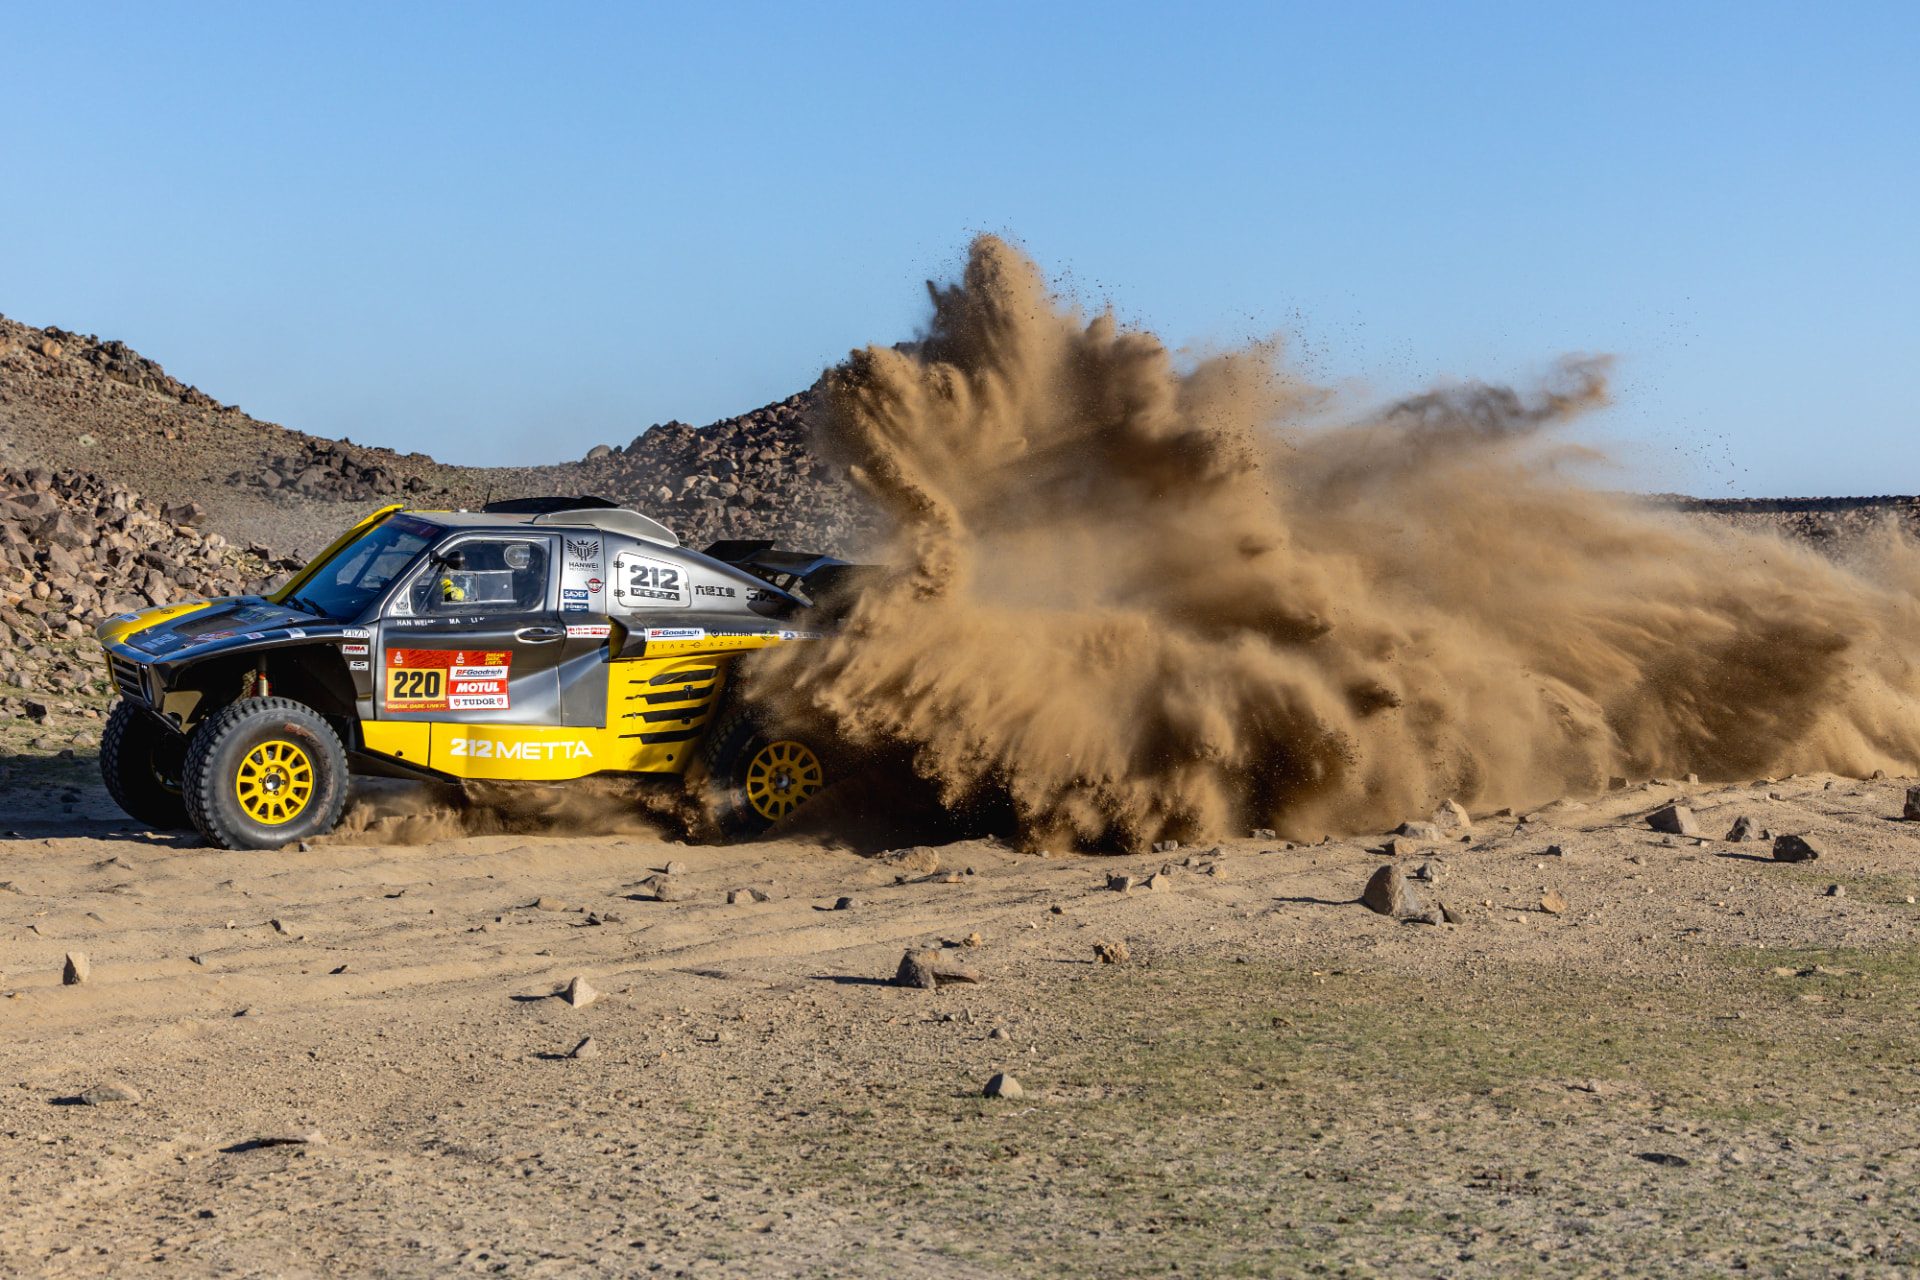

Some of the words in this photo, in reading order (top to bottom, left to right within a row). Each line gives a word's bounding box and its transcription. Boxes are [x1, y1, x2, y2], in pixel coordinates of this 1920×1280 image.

[569, 561, 599, 569] HANWEI
[630, 564, 680, 591] 212
[564, 590, 588, 598] SADEV
[633, 588, 678, 600] METTA
[397, 619, 412, 627] HAN
[413, 619, 428, 627] WEI
[651, 629, 700, 637] BFGoodrich
[393, 671, 441, 699] 220
[456, 682, 500, 693] MOTUL
[450, 738, 492, 758] 212
[496, 740, 593, 760] METTA
